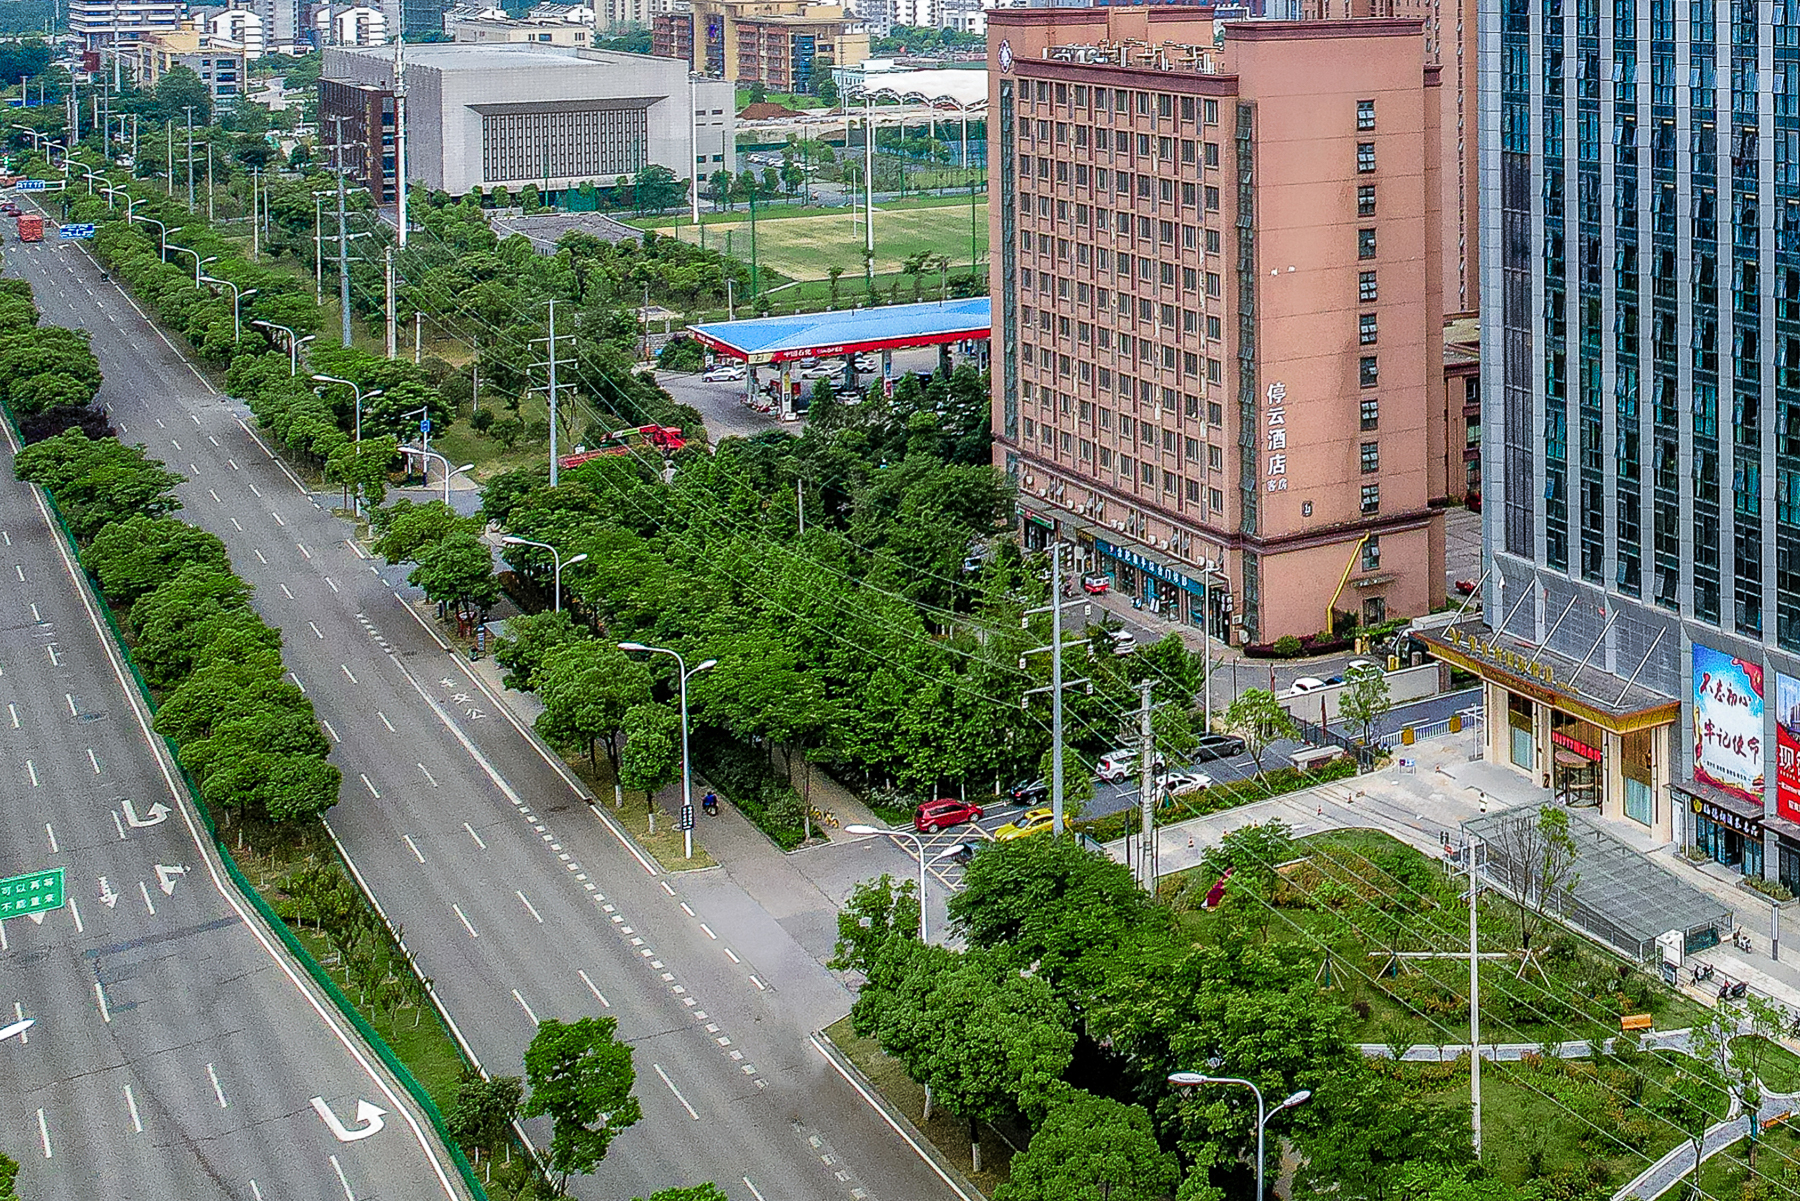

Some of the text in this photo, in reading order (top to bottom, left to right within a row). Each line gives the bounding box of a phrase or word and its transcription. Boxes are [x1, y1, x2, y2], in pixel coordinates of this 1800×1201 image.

[1266, 381, 1287, 476] 停云酒店
[1700, 672, 1752, 707] 不忘初心
[1703, 718, 1760, 765] 牢记使命
